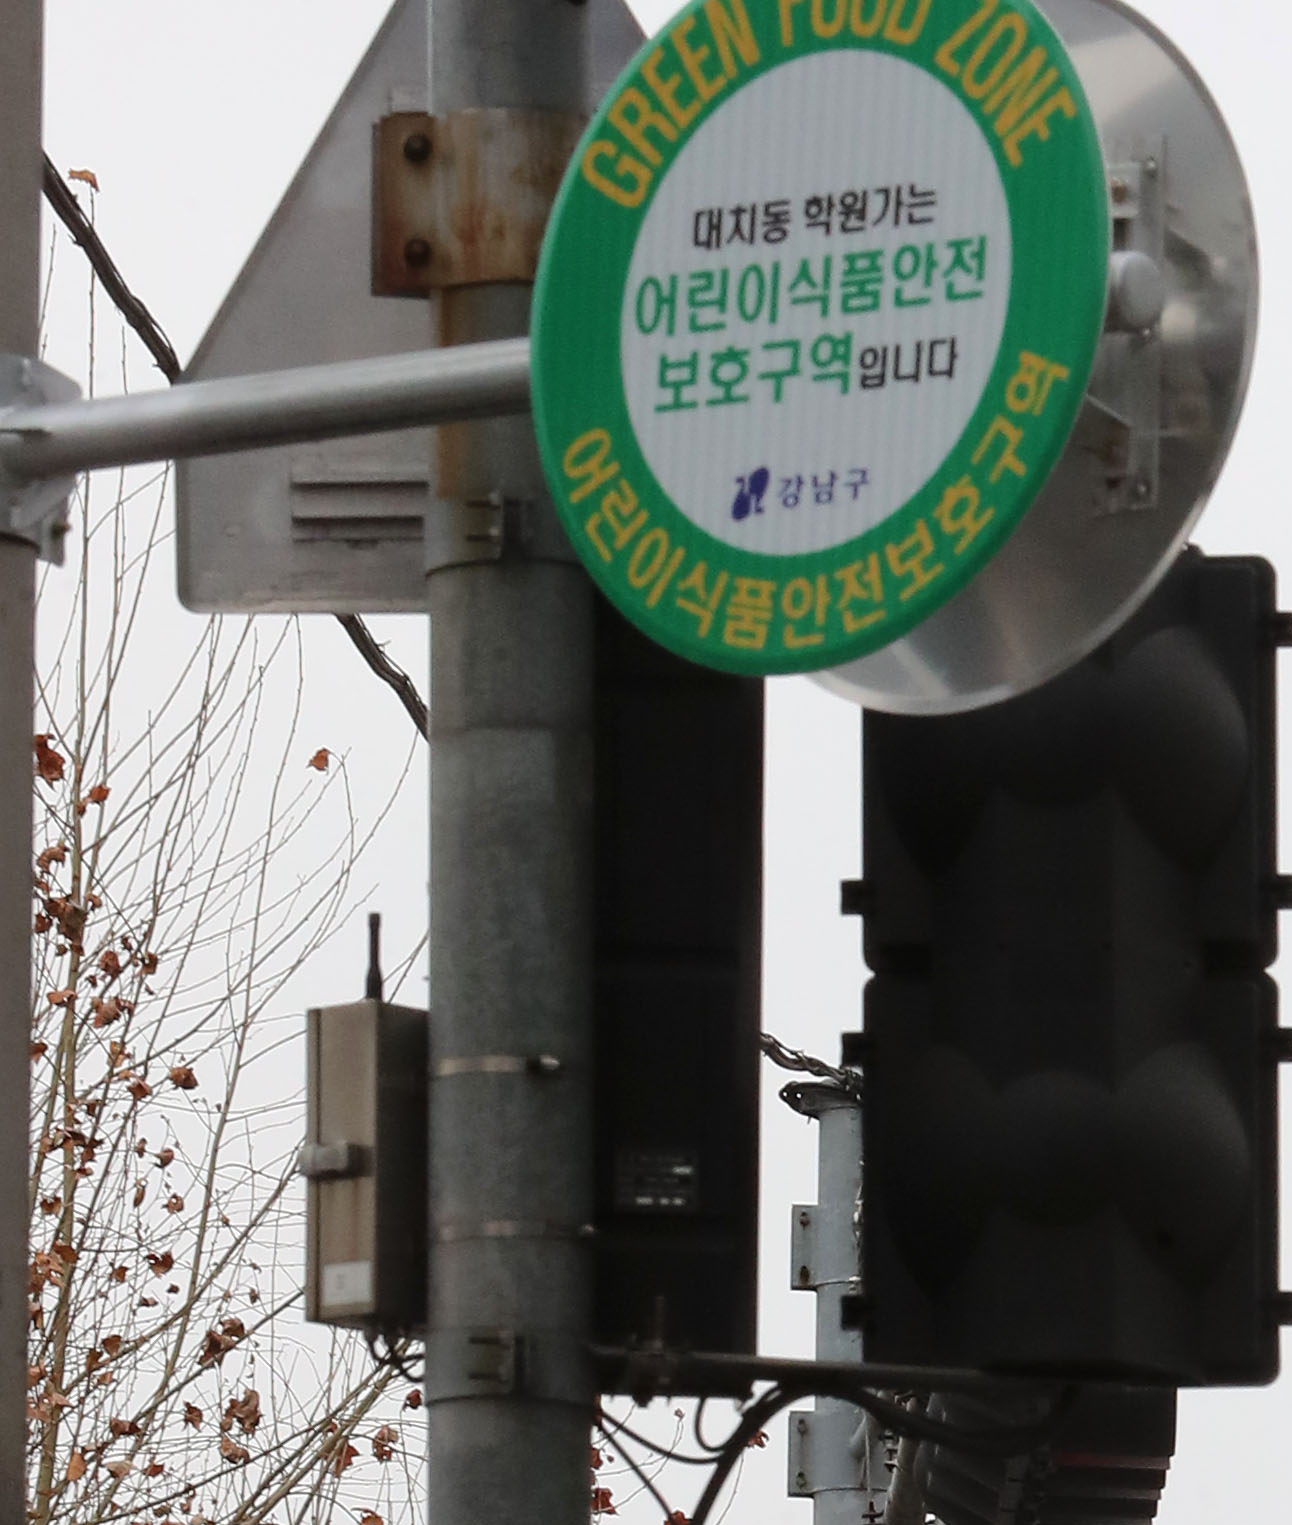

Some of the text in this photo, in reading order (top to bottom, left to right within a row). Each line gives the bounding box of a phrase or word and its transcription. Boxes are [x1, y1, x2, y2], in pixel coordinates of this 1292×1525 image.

[580, 0, 762, 208] GREEN
[933, 0, 1077, 168] ZONE
[692, 184, 937, 250] 대치동 학원가는
[634, 234, 988, 337] 어린이식품안전
[562, 351, 1070, 651] 어린이식품안전보호구역
[777, 469, 872, 508] 강남구
